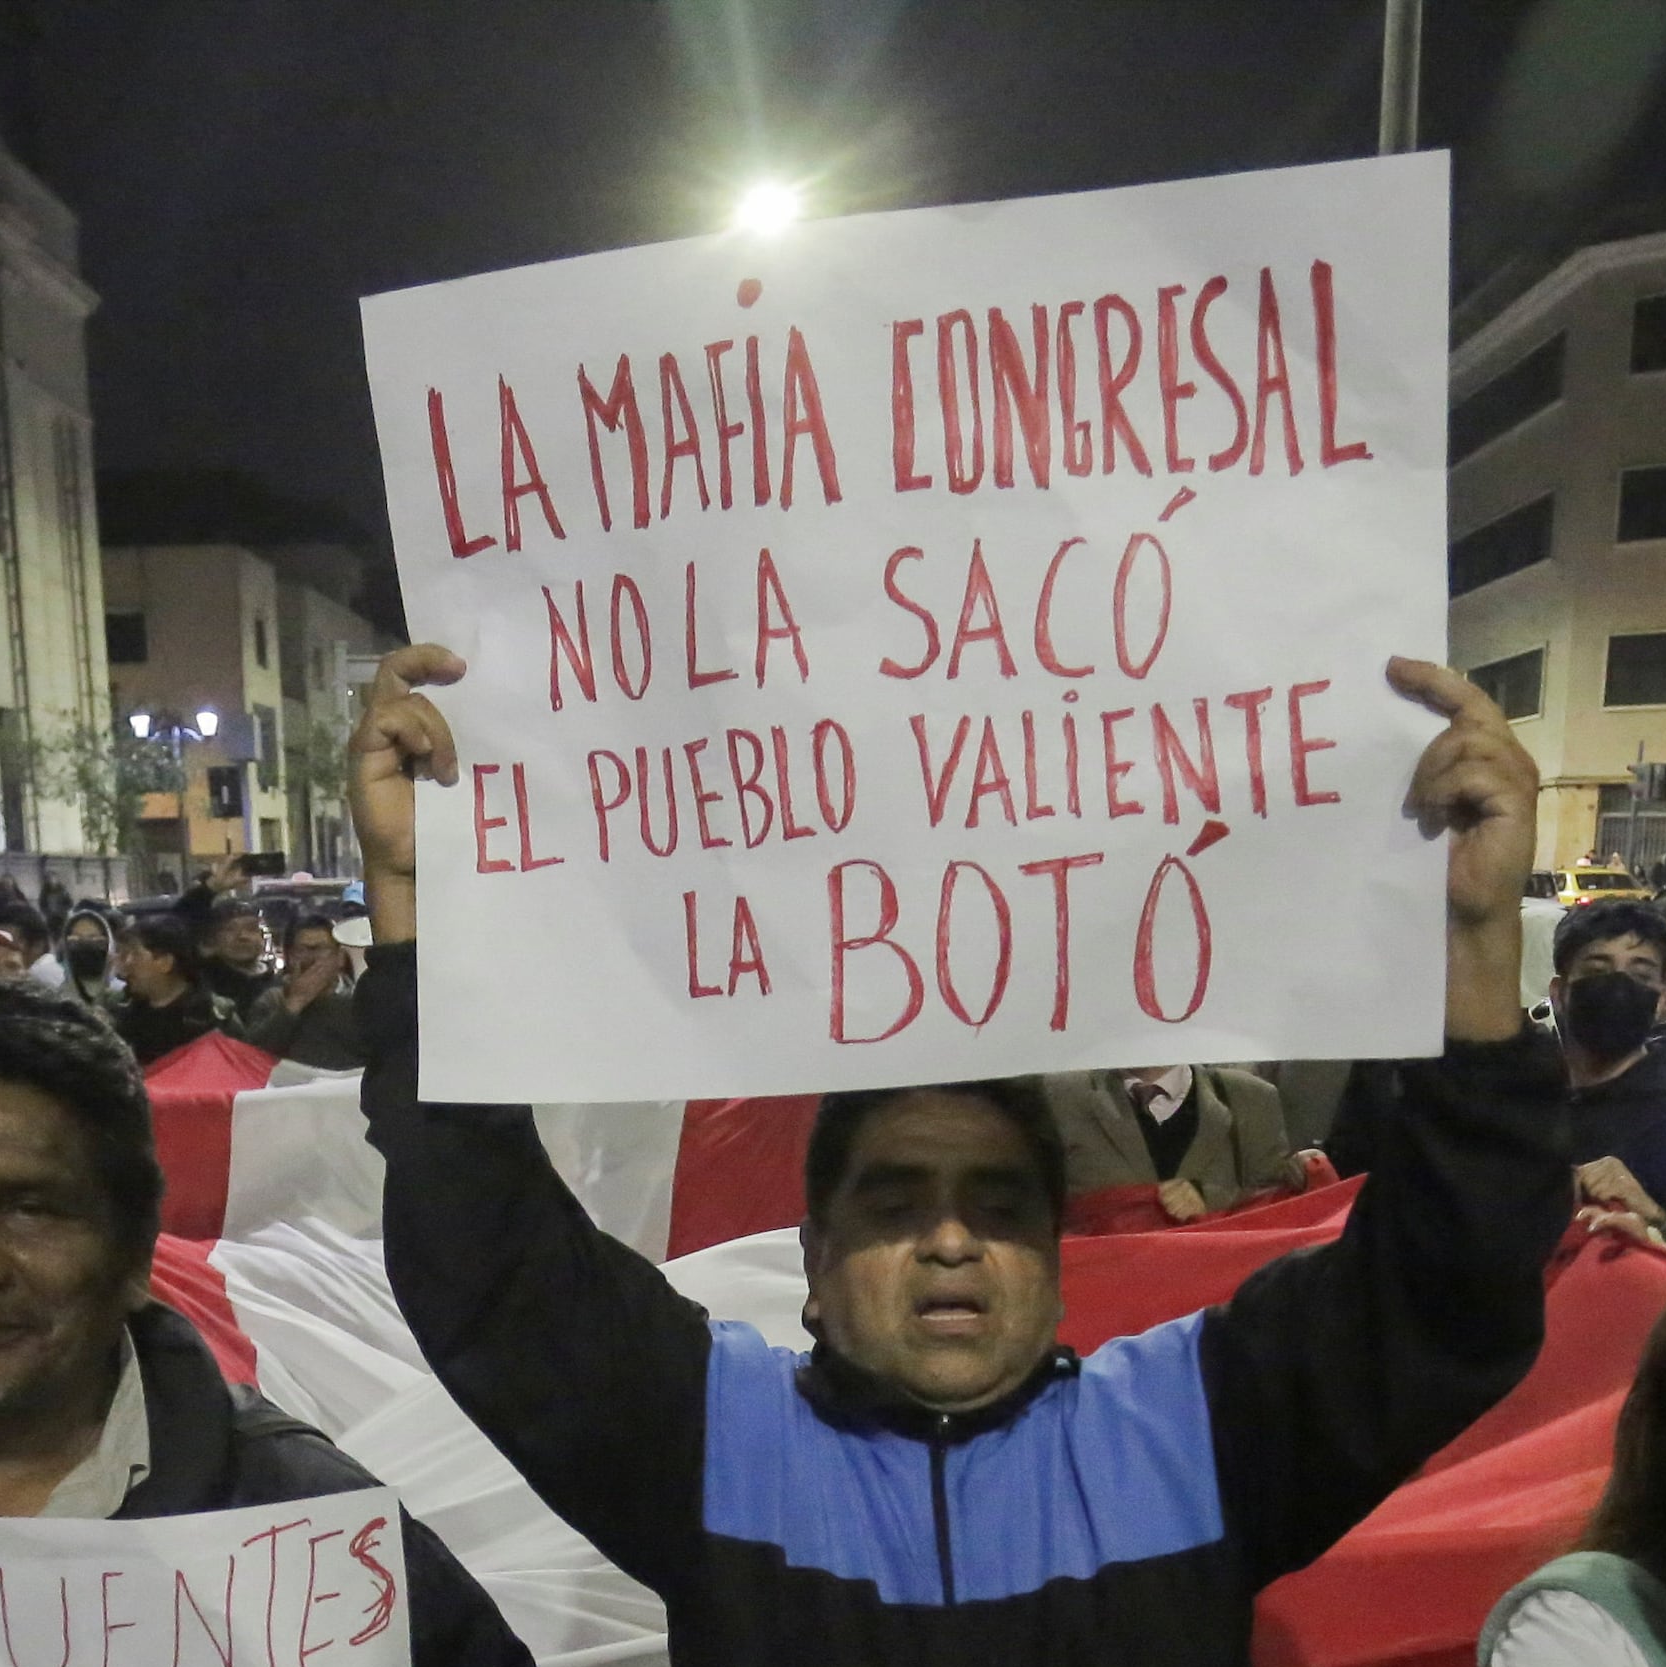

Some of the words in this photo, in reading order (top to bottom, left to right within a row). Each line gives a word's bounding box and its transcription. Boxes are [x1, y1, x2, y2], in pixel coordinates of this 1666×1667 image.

[427, 372, 566, 559] LA
[890, 258, 1374, 495] CONGRESAL
[540, 573, 653, 712] NO
[684, 546, 811, 690] LA
[878, 486, 1198, 680] SACÓ
[471, 761, 567, 876] EL
[586, 716, 858, 863] PUEBLO
[682, 889, 773, 1000] LA
[824, 817, 1231, 1046] BOTÓ
